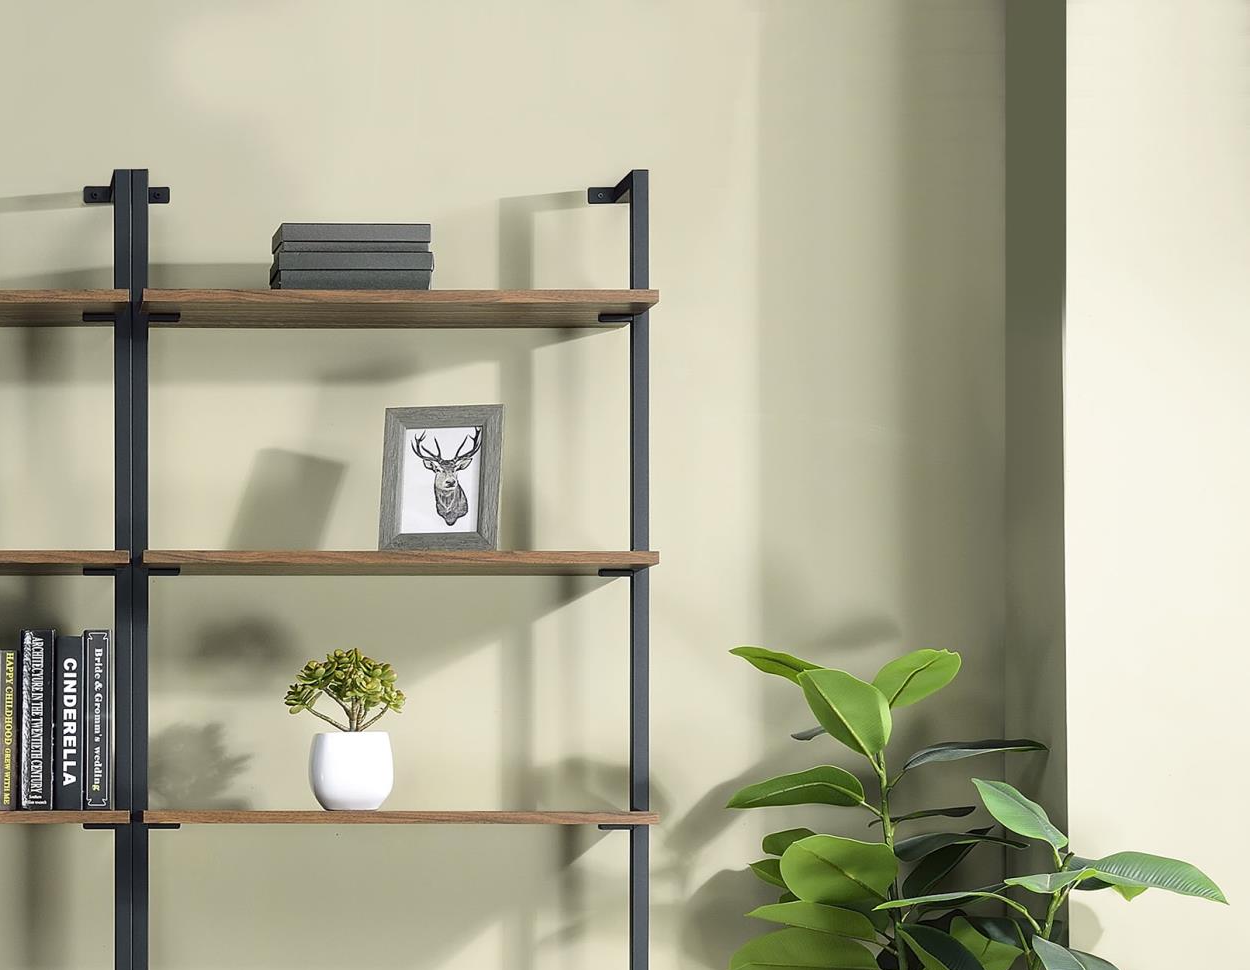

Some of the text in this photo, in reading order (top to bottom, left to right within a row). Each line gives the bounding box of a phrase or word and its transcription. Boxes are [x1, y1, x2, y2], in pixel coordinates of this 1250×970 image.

[94, 648, 103, 679] Bride
[31, 693, 44, 701] IN
[94, 680, 103, 691] &
[31, 702, 44, 716] THE
[62, 657, 78, 786] CINDERELLA
[3, 652, 15, 805] HAPPY CHILDHOOD GREW WITH ME
[30, 759, 43, 794] CENTURY
[91, 747, 103, 791] wedding
